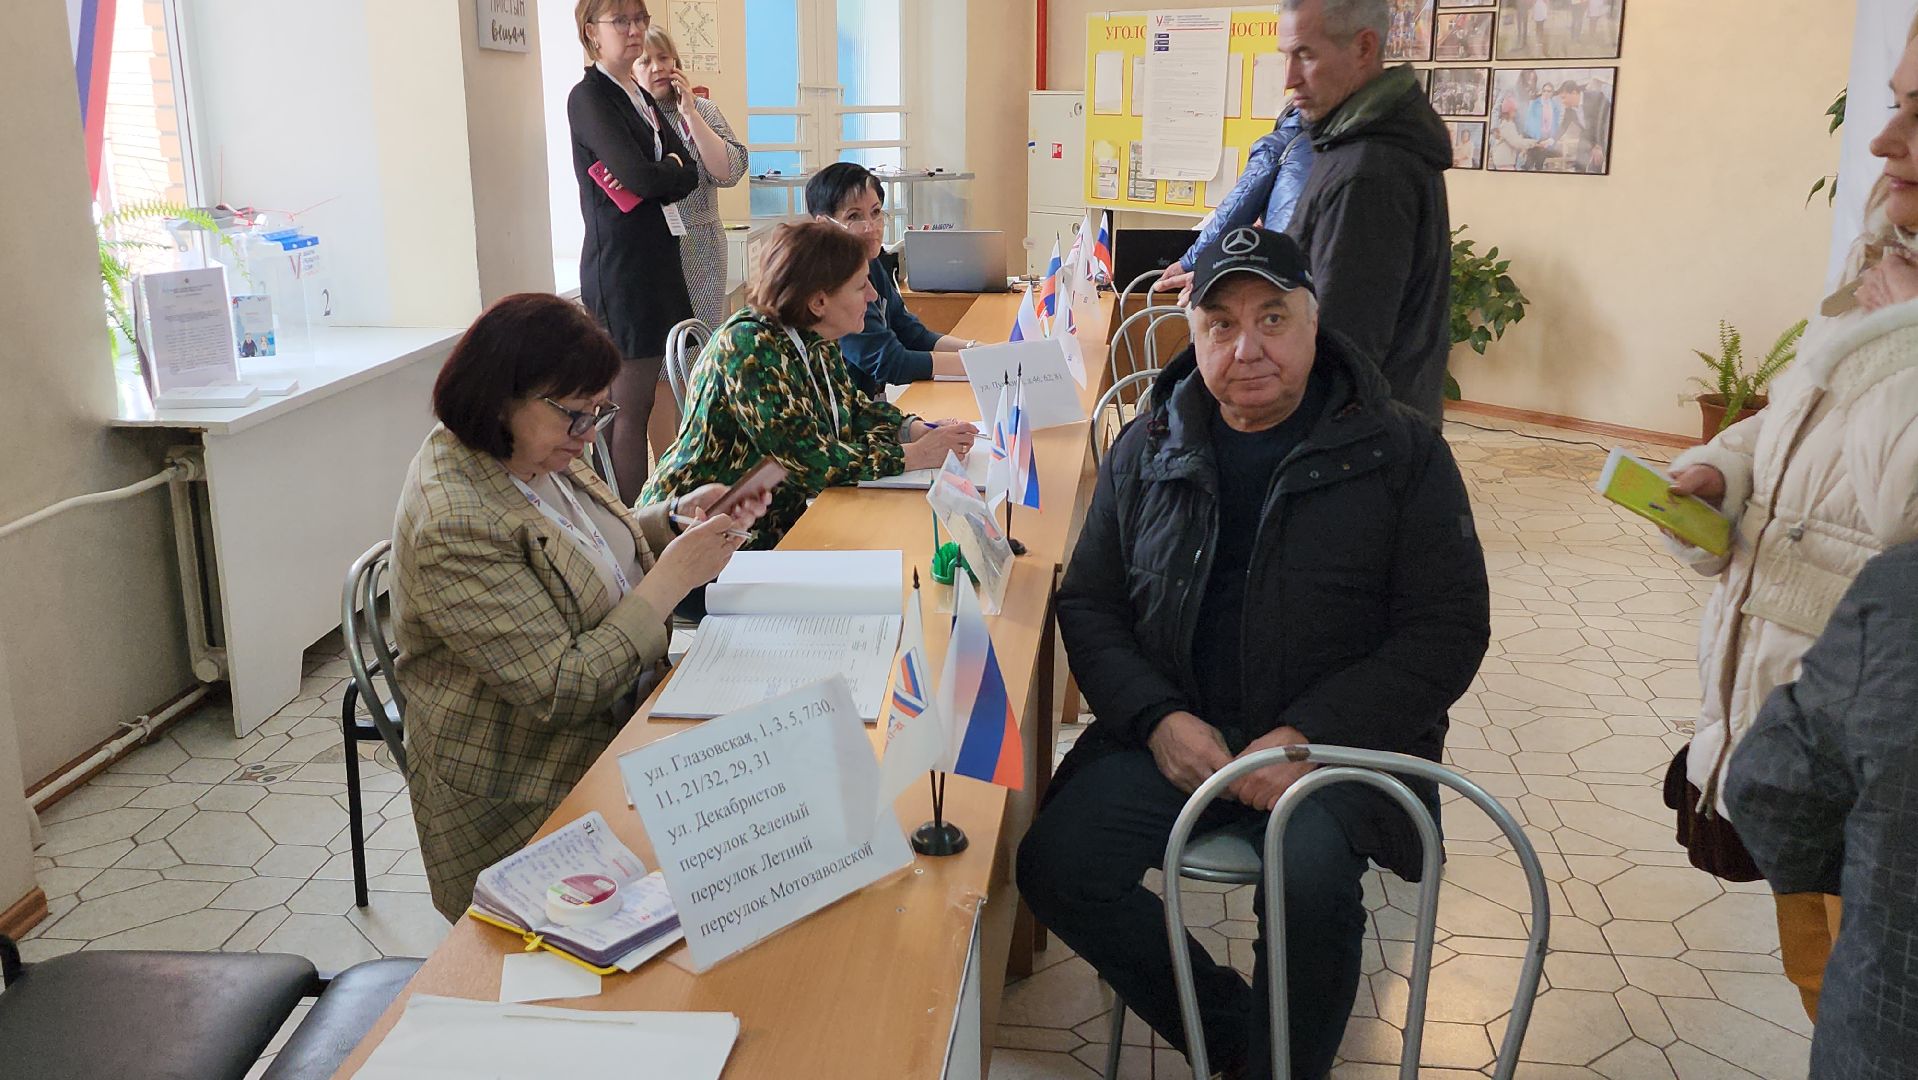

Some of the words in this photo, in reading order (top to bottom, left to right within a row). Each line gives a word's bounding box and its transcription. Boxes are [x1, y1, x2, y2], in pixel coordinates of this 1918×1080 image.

[644, 767, 669, 786] ул.
[671, 731, 758, 772] Глазовская,
[759, 723, 773, 737] 1,
[772, 716, 788, 732] 3,
[789, 711, 803, 726] 5,
[802, 698, 835, 720] 7/30,
[656, 790, 680, 809] 11,
[681, 770, 729, 799] 21/32,
[729, 759, 753, 779] 29,
[753, 750, 771, 769] 31
[667, 822, 692, 845] ул.
[695, 782, 787, 832] Декабристов
[679, 832, 749, 872] переулок
[749, 802, 810, 841] Зеленый
[690, 864, 759, 904] переулок
[760, 835, 814, 872] Летний
[700, 895, 769, 937] переулок
[770, 841, 874, 902] Мотозаводской
